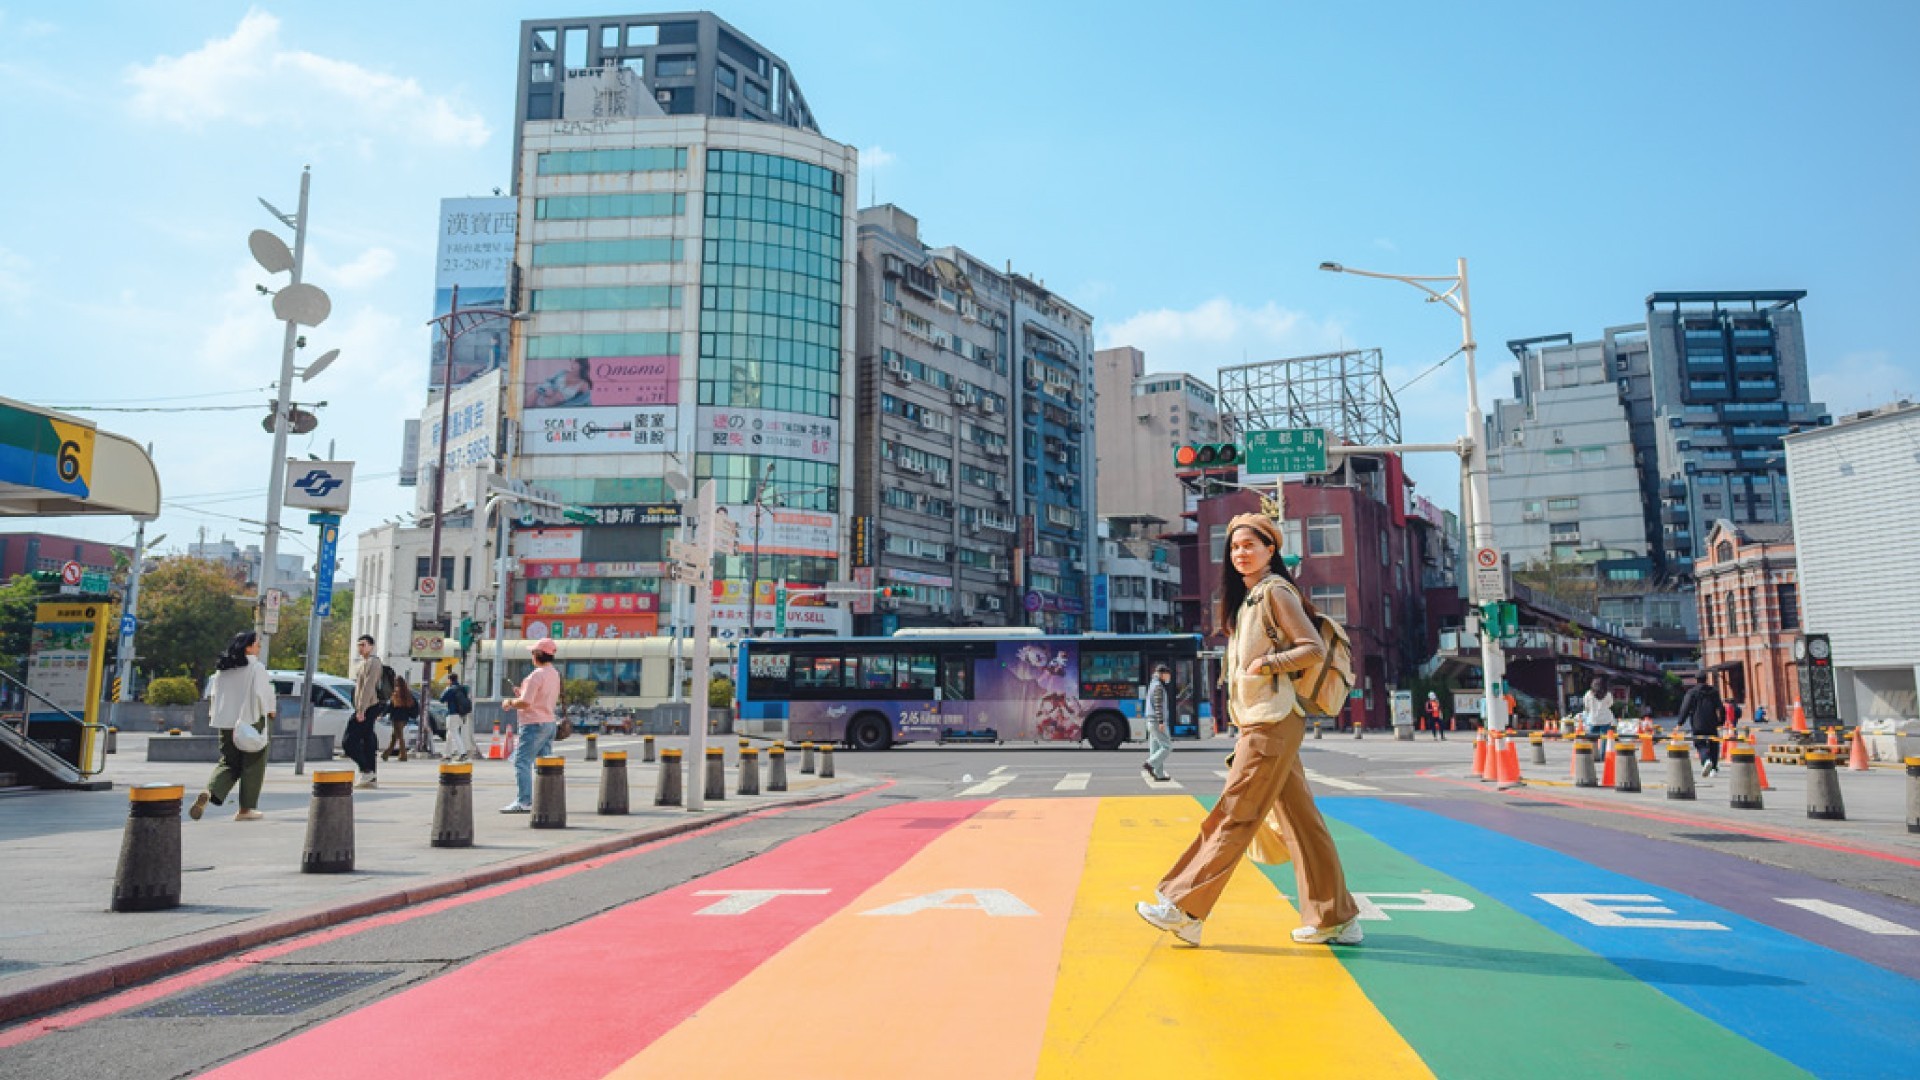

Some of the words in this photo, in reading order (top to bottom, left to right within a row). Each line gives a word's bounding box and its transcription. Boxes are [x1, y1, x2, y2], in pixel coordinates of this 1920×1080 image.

[546, 430, 578, 443] GAME
[60, 440, 81, 482] 6
[786, 610, 826, 624] UY.SELL
